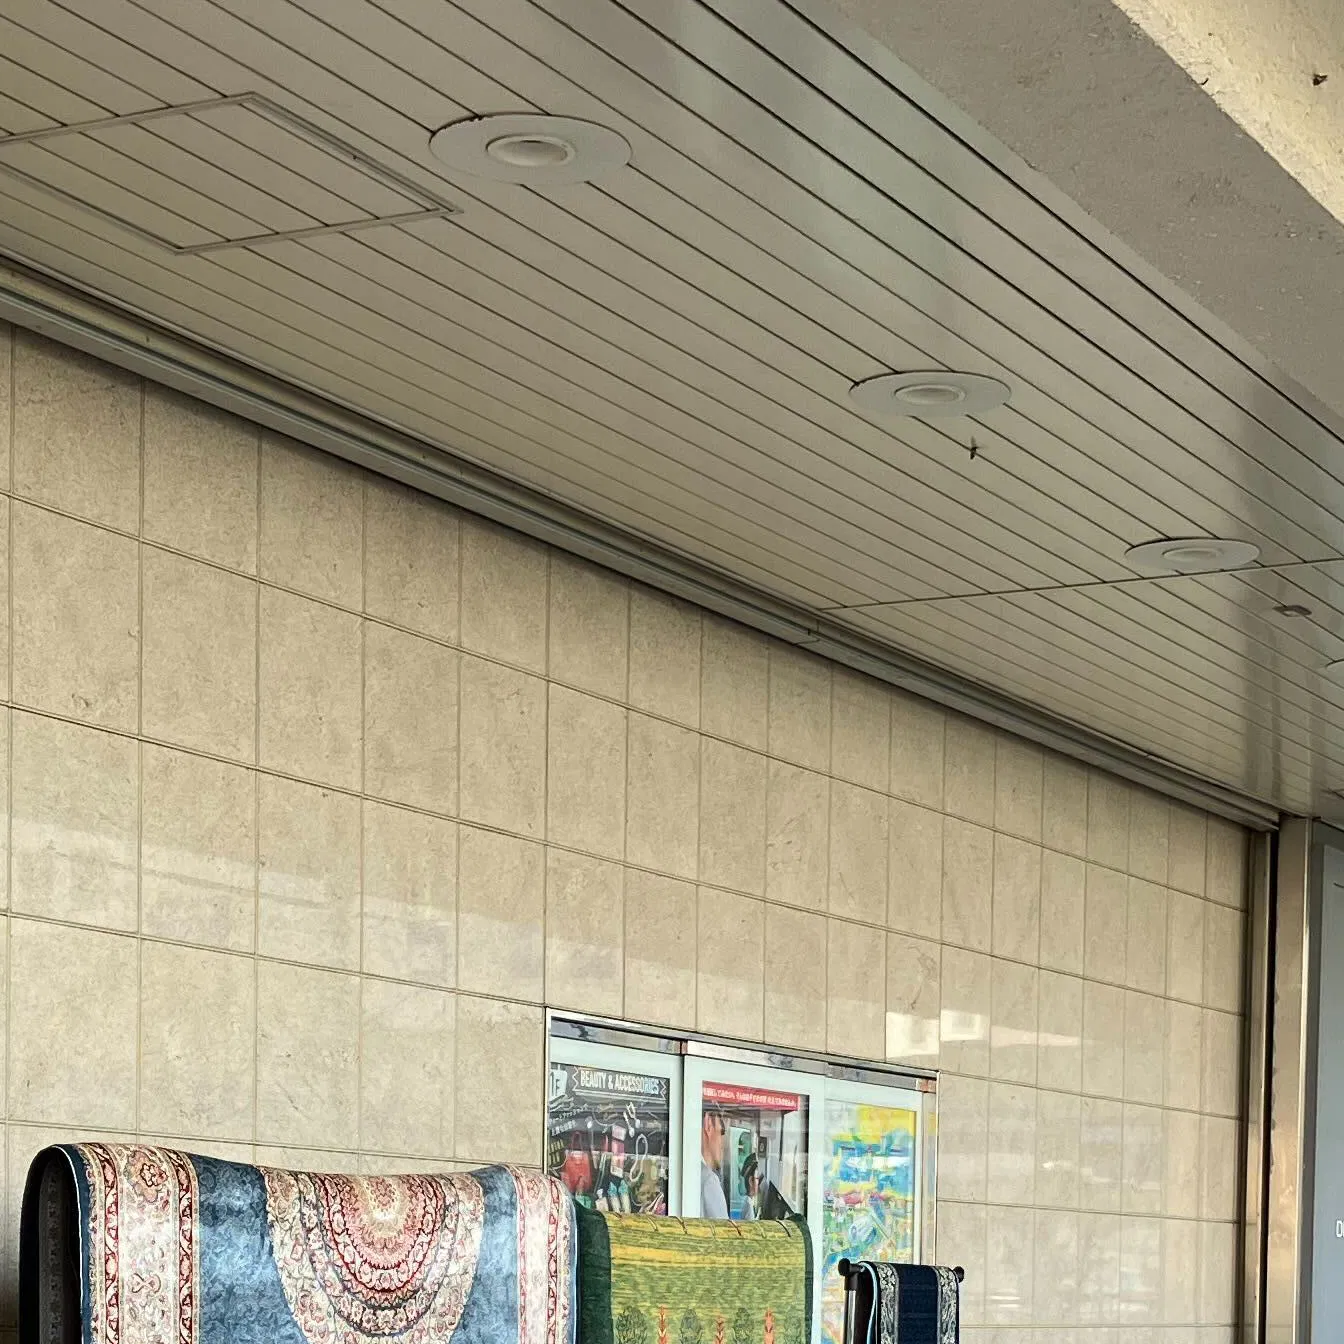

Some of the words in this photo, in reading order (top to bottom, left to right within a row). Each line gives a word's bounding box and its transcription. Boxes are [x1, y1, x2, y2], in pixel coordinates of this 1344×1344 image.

[580, 1070, 607, 1088] BEAUTY
[608, 1072, 614, 1090] &
[615, 1073, 659, 1094] ACCESSORIES
